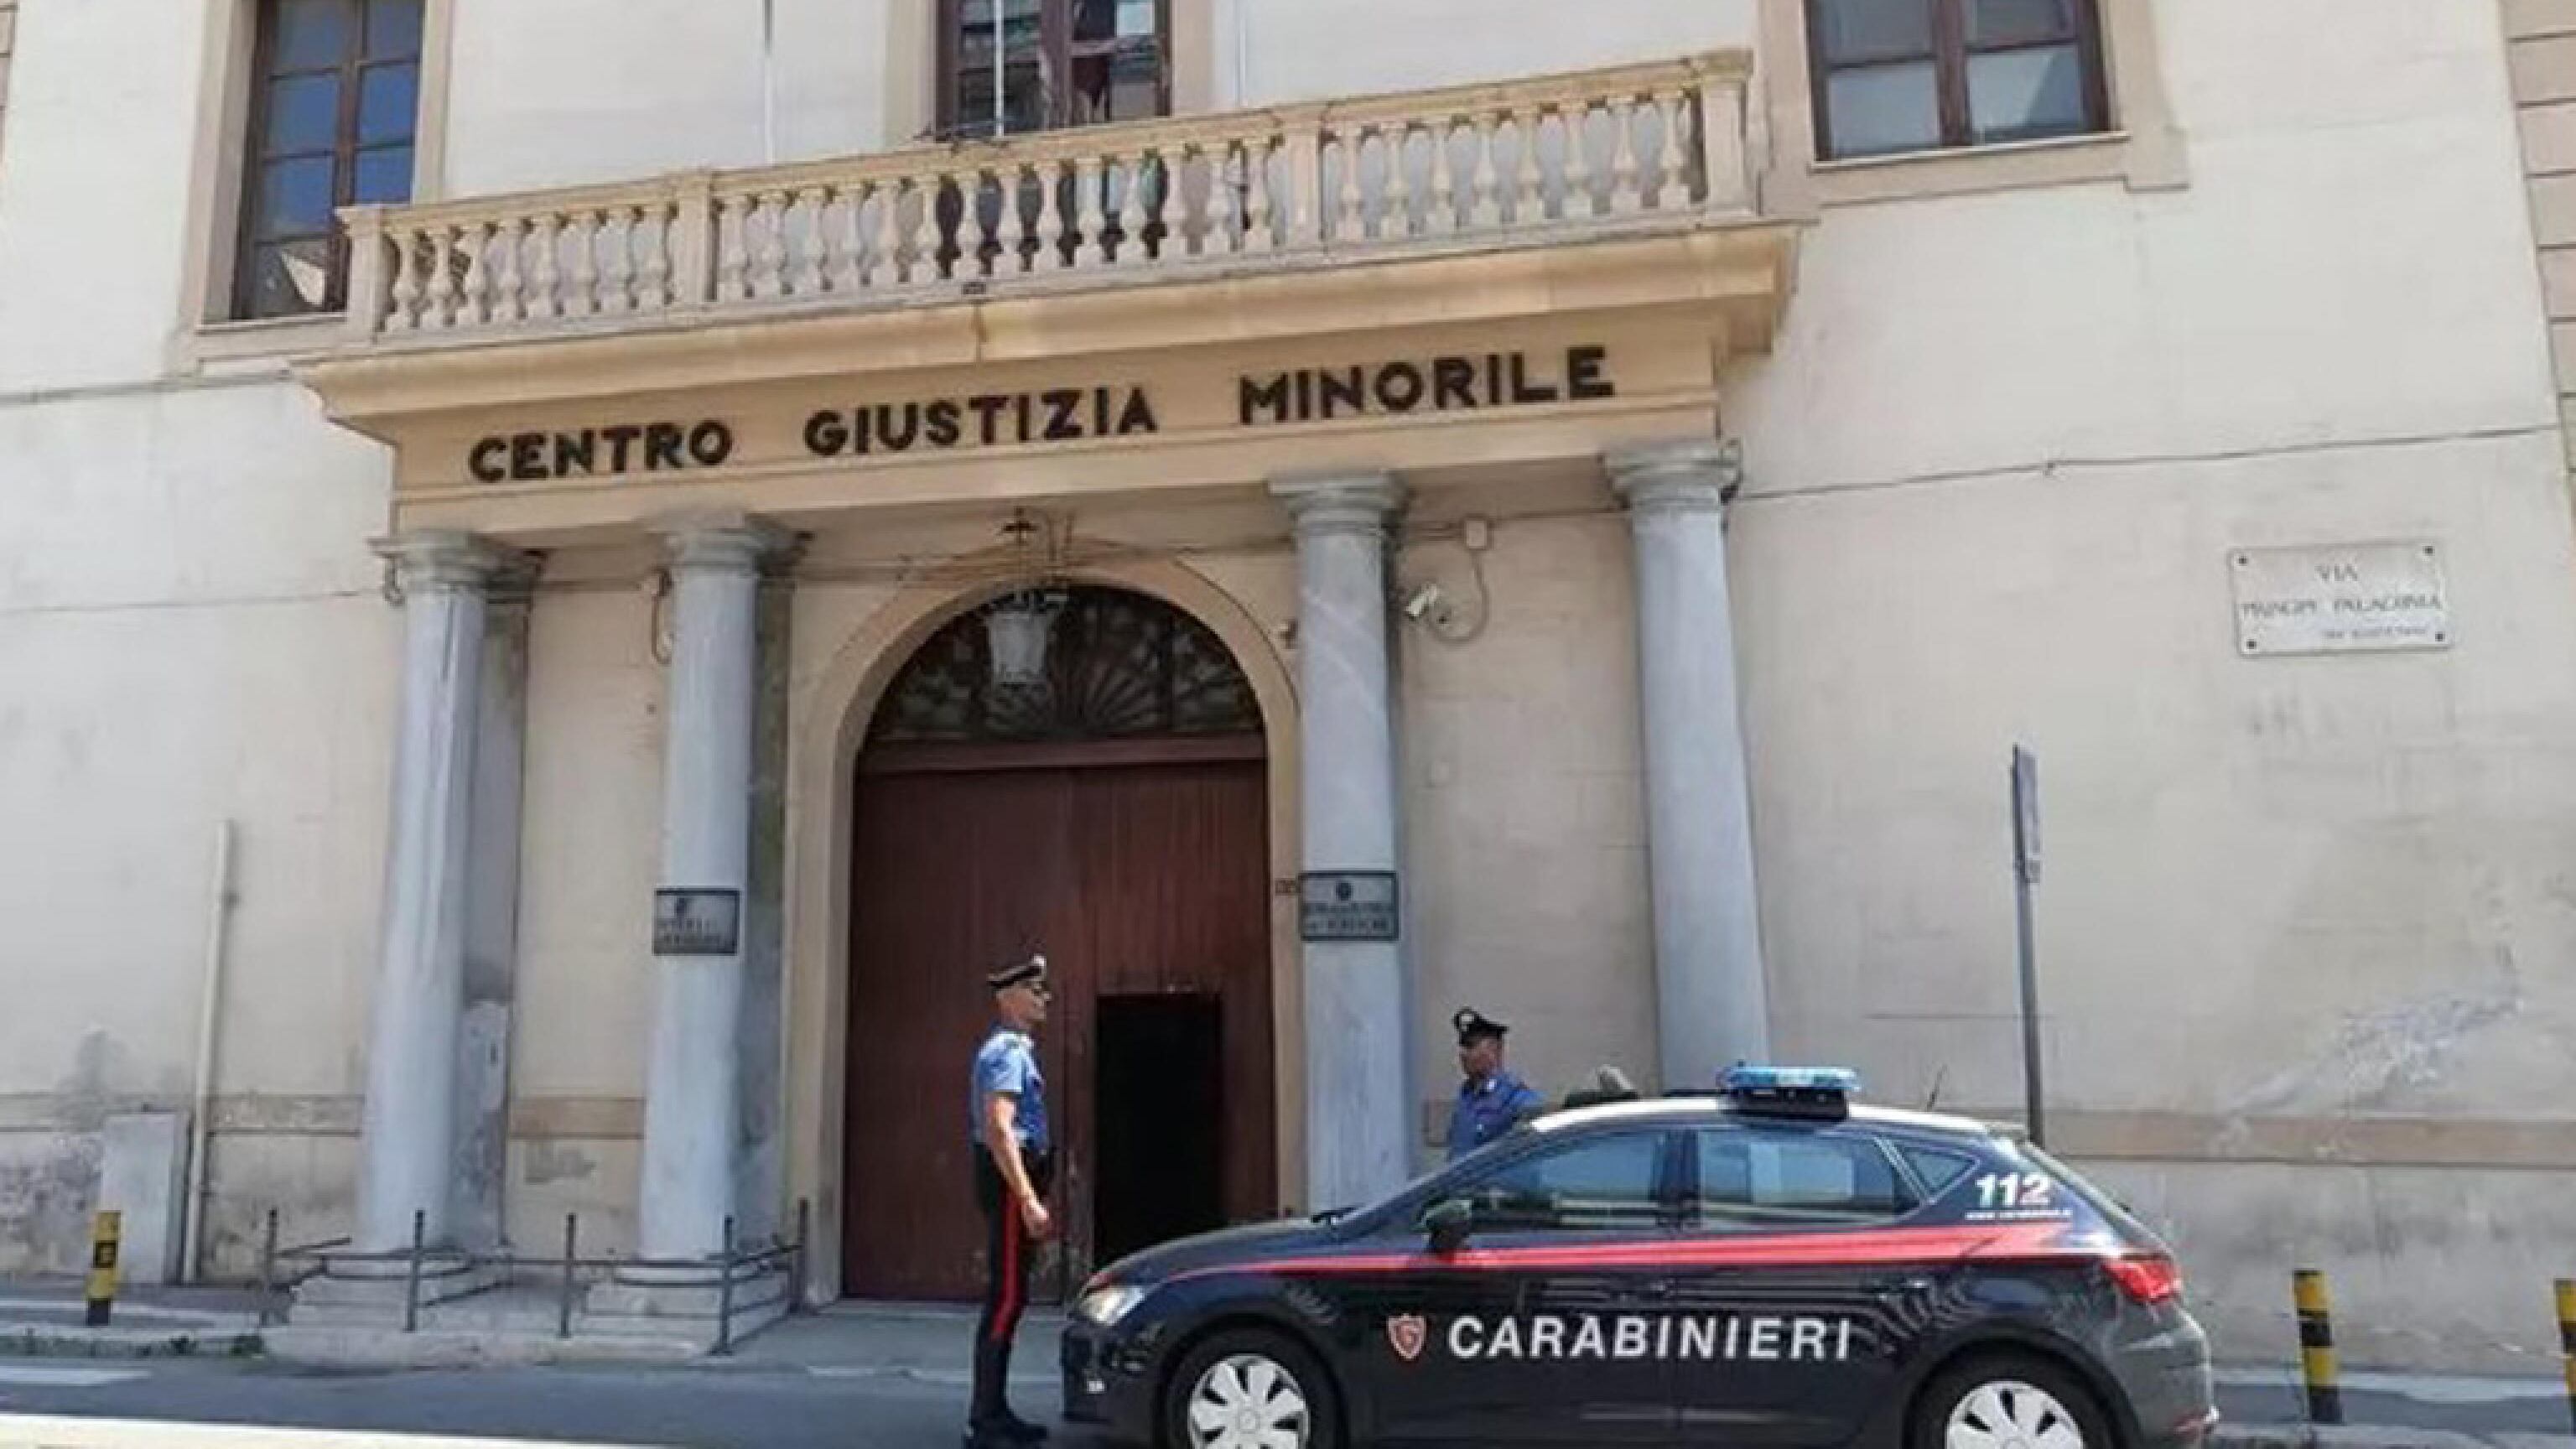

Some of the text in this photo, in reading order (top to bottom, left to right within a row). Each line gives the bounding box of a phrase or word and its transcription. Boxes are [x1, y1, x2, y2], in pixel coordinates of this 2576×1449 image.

[469, 345, 1616, 484] CENTRO GIUSTIZIA MINORILE
[2314, 563, 2360, 583] VIA
[1976, 1173, 2050, 1208] 112
[1448, 1315, 1851, 1360] CARABINIERI
